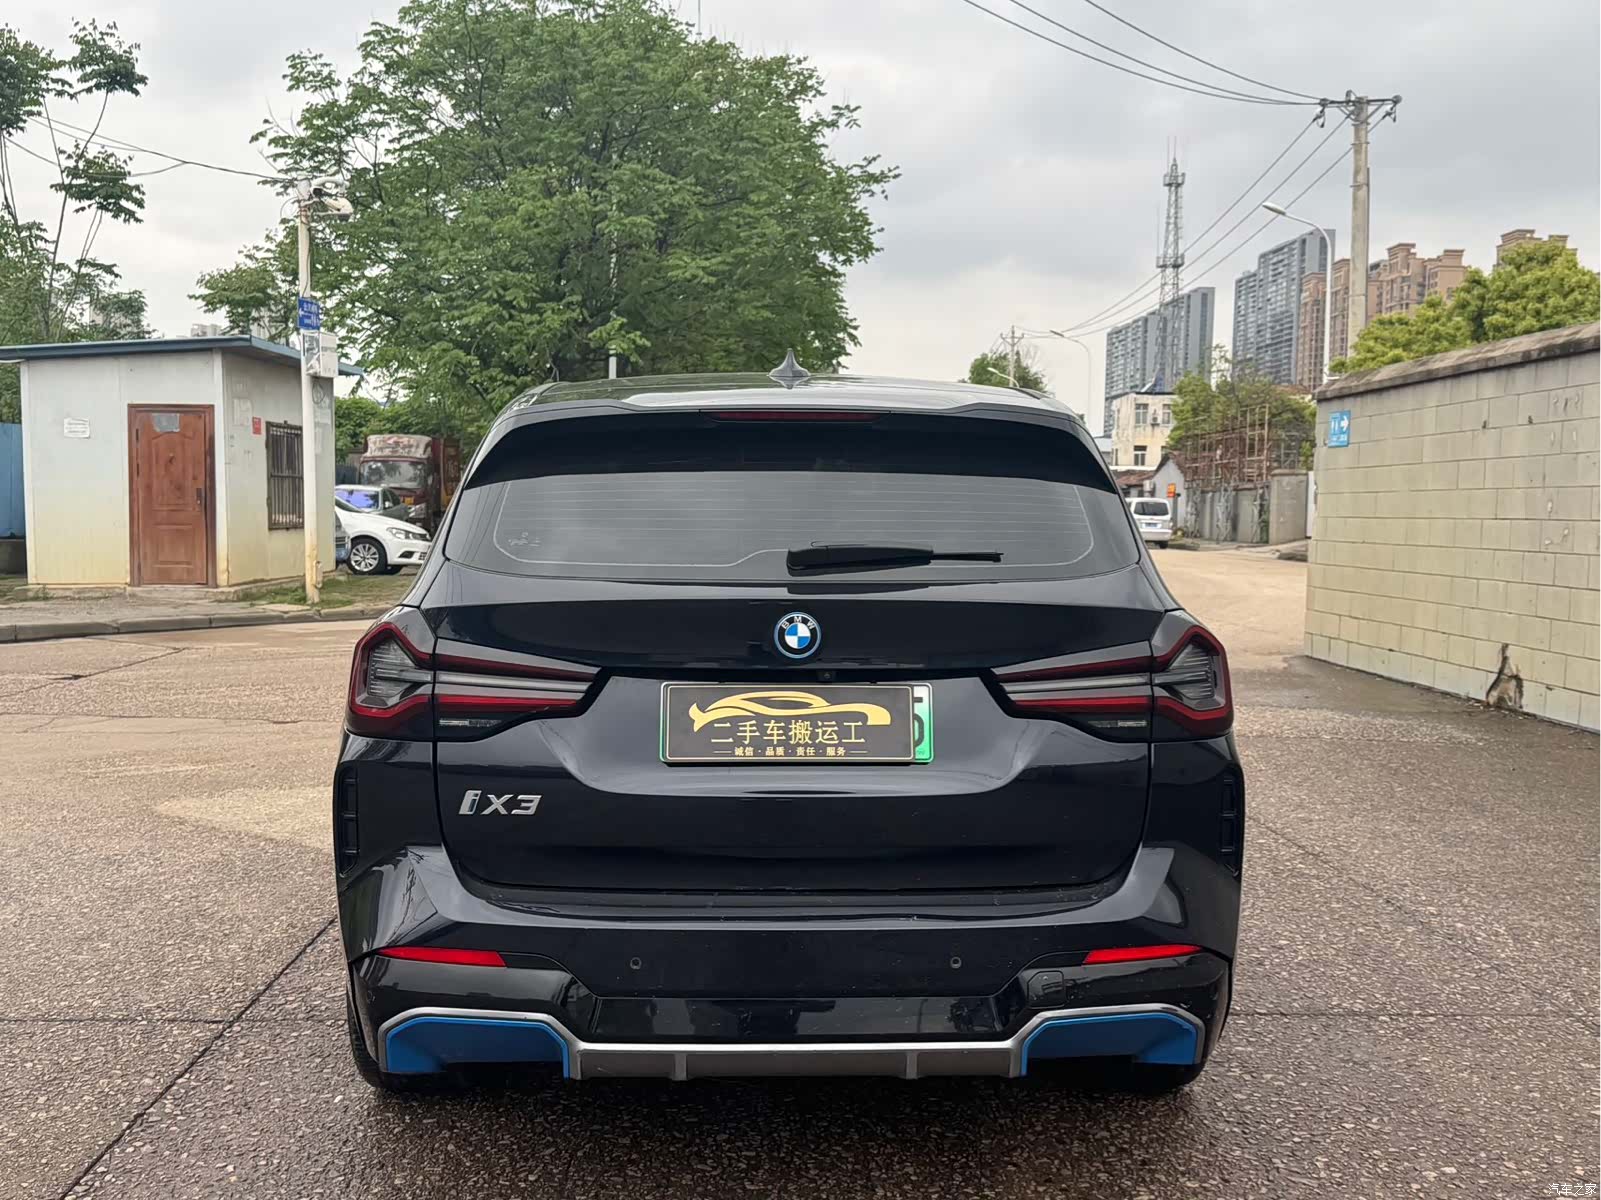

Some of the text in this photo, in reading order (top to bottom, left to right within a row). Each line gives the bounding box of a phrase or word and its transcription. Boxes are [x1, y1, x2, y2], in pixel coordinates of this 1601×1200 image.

[781, 616, 816, 630] BMW
[710, 719, 866, 745] 二手车搬运工
[458, 789, 543, 815] iX3
